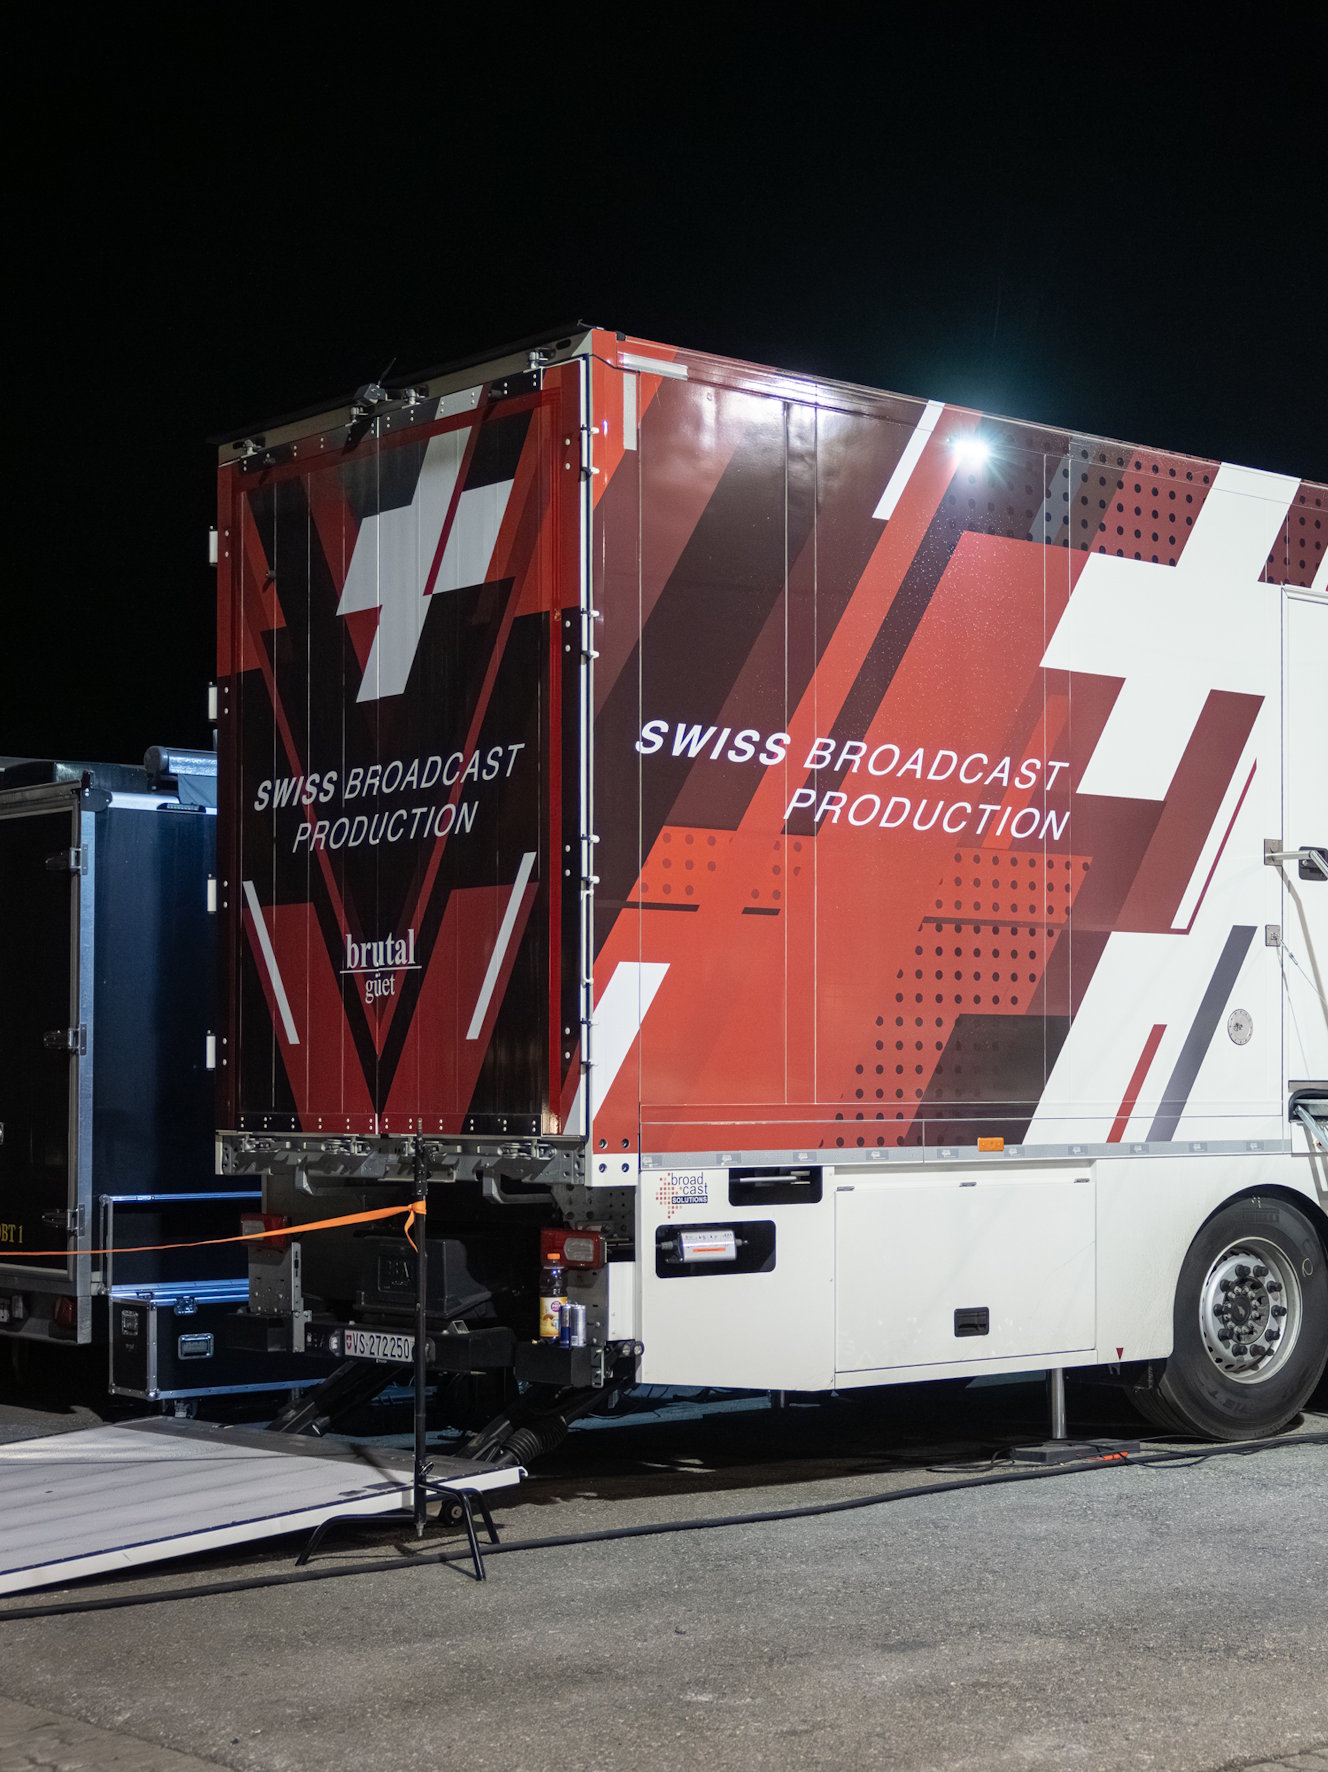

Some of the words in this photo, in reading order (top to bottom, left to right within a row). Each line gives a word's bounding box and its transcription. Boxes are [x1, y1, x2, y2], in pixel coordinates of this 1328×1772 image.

[635, 720, 791, 766] SWISS
[803, 737, 1069, 791] BROADCAST
[254, 771, 338, 811] SWISS
[344, 743, 525, 799] BROADCAST
[292, 801, 479, 853] PRODUCTION
[783, 788, 1070, 841] PRODUCTION
[345, 928, 416, 969] brutal
[365, 973, 396, 1004] güet
[671, 1171, 704, 1186] broad
[682, 1182, 708, 1195] cast
[672, 1196, 708, 1204] SOLUTIONS
[0, 1223, 16, 1243] BT
